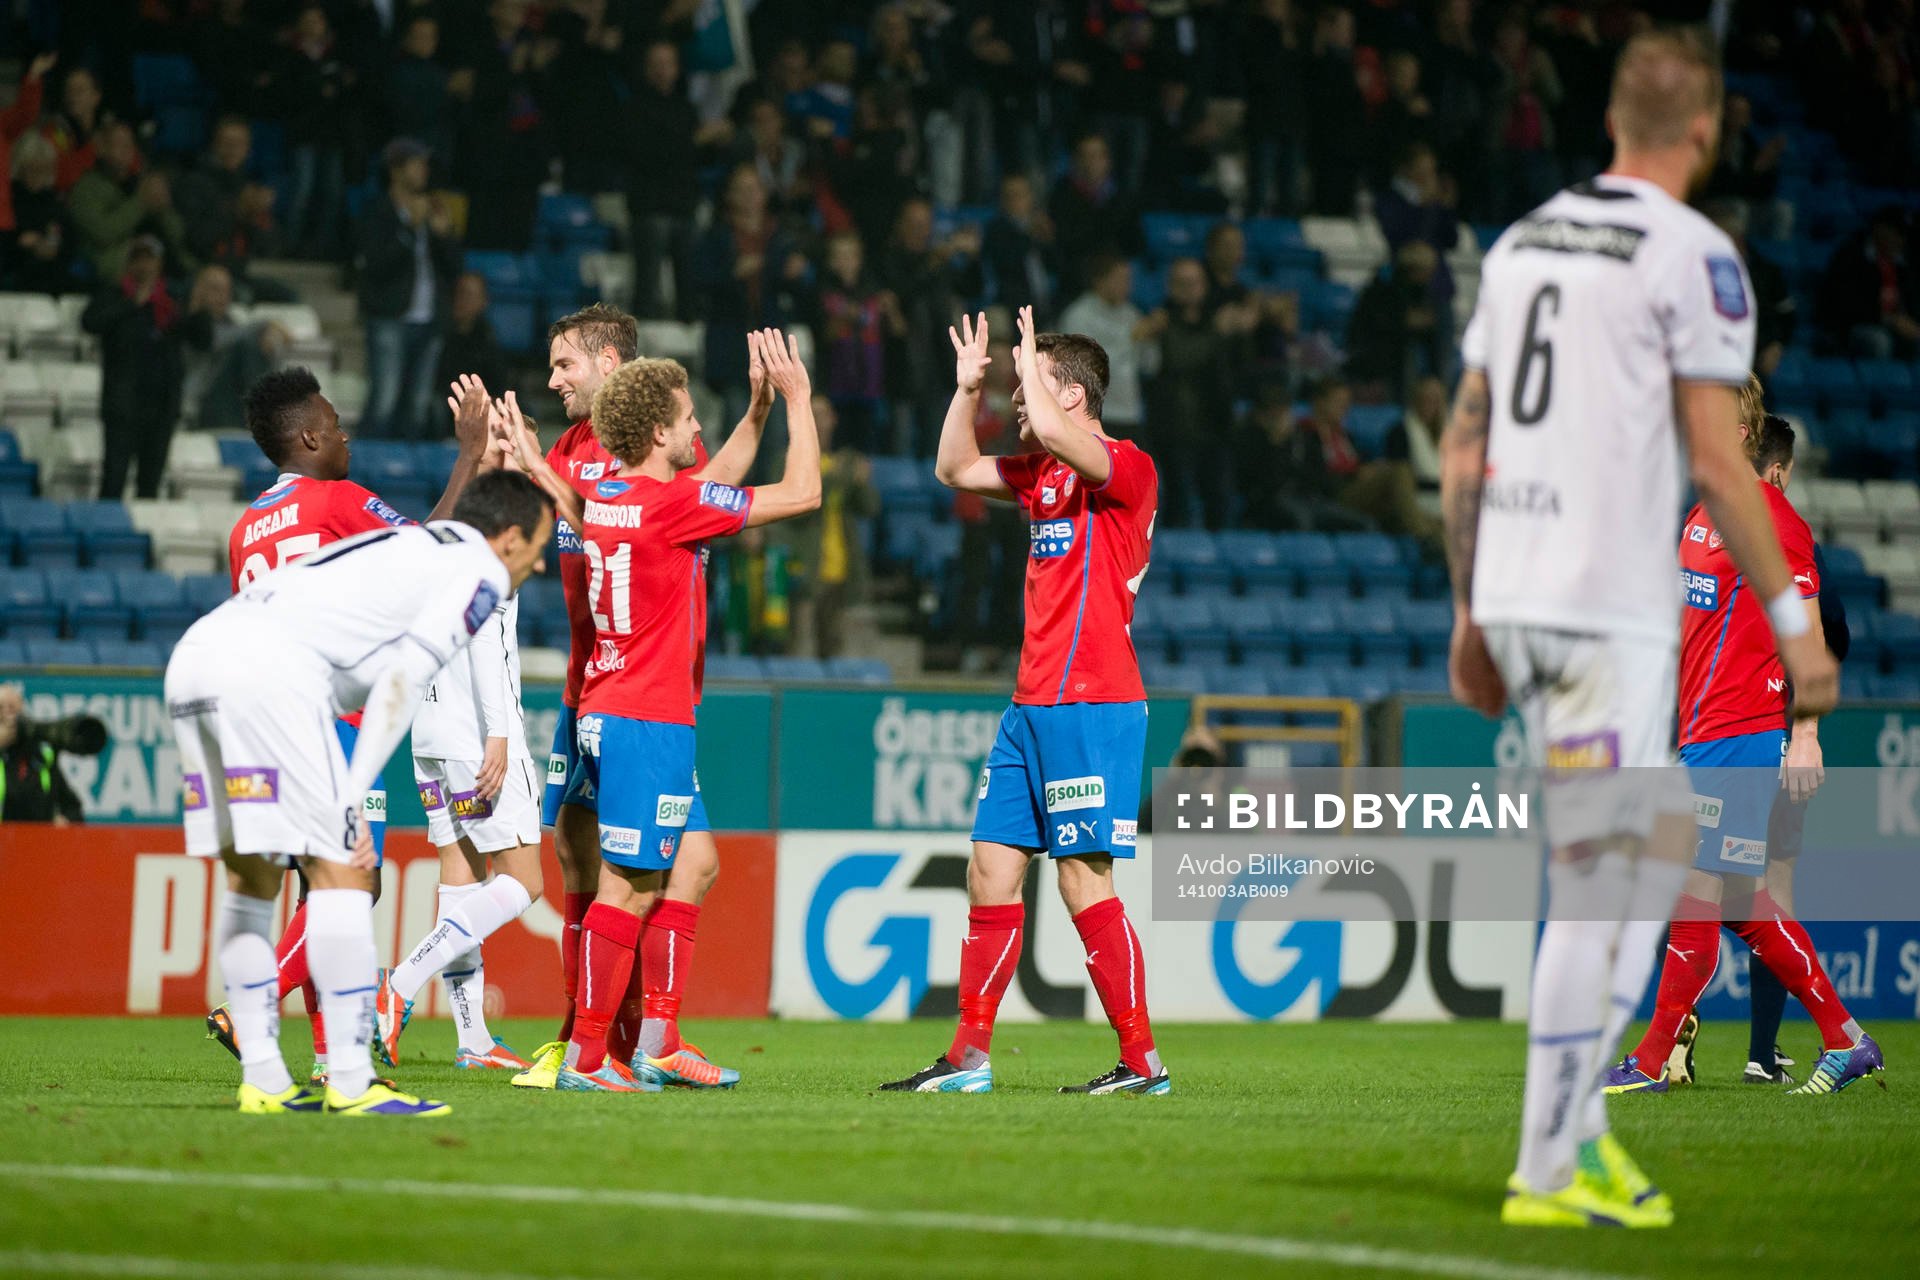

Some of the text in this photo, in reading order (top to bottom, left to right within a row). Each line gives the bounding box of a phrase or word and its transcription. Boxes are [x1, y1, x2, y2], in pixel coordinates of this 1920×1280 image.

[1511, 281, 1562, 425] 6
[242, 503, 299, 549] ACCAM
[583, 539, 632, 635] 21
[1057, 783, 1103, 800] SOLID
[1057, 822, 1079, 847] 29
